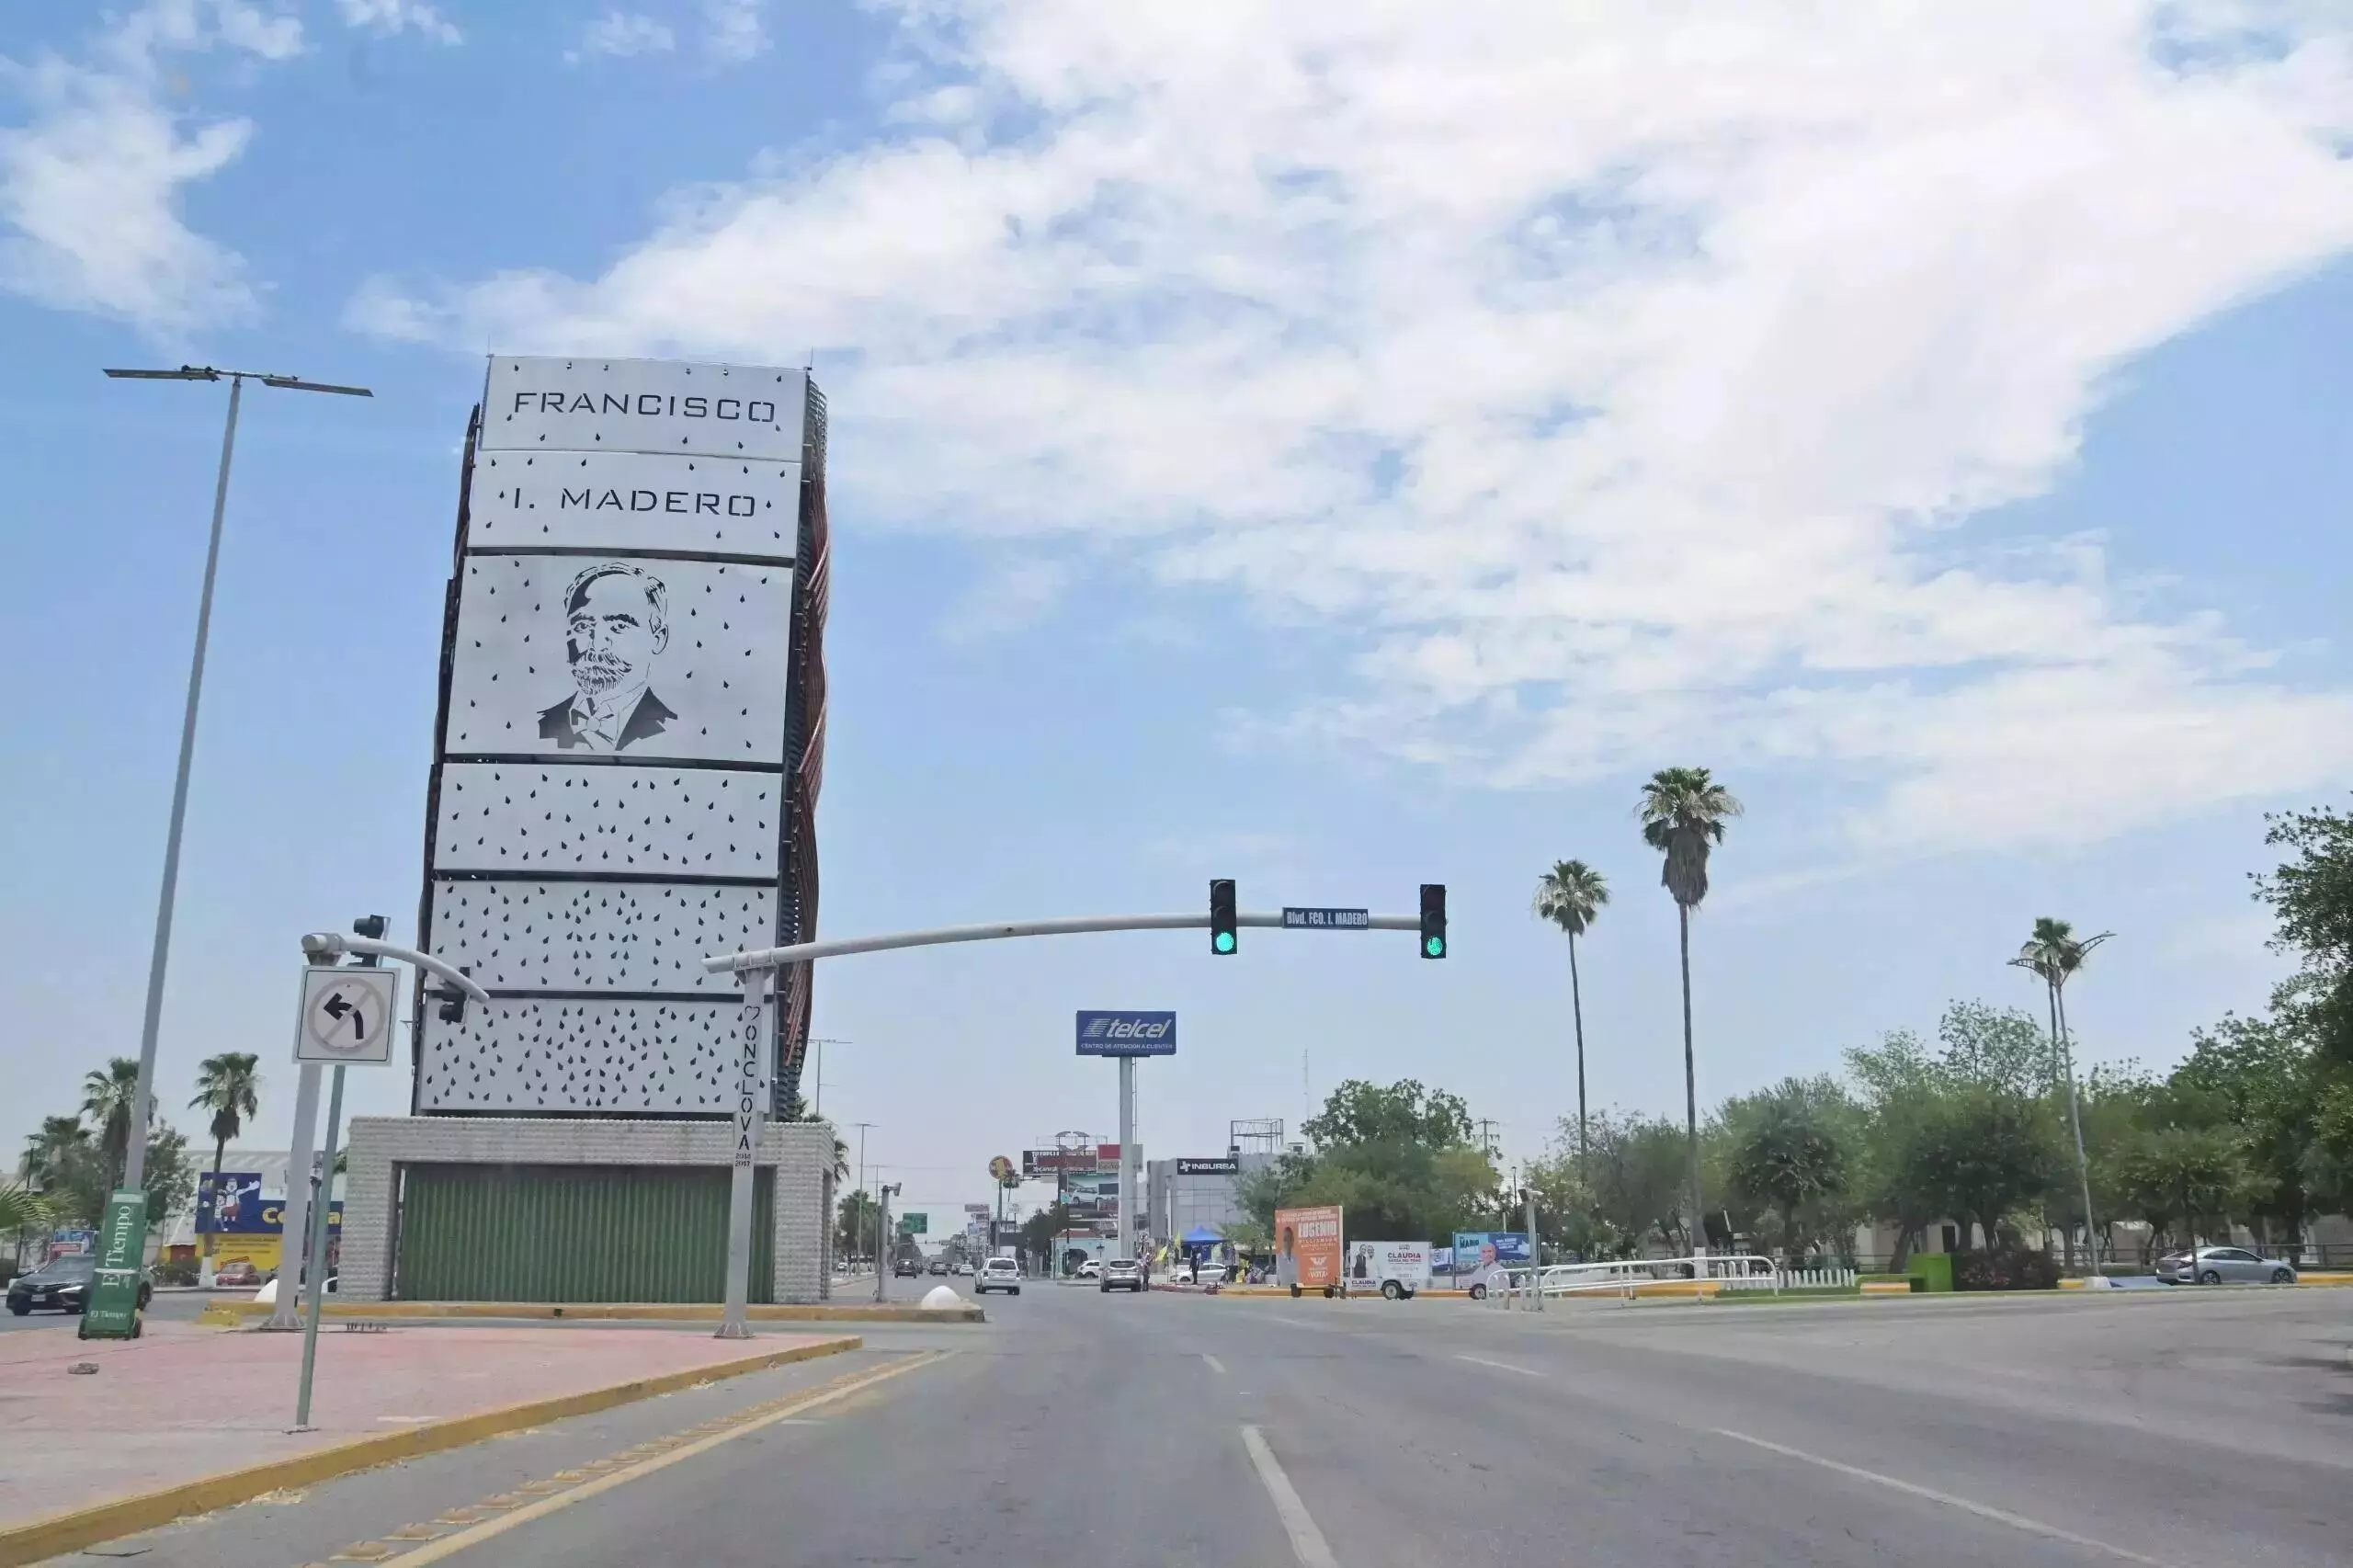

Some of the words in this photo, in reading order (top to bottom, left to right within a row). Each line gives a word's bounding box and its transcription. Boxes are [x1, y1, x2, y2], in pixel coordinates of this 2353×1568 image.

[514, 392, 775, 422] FRANCISCO
[514, 488, 535, 508] I.
[561, 488, 756, 517] MADERO
[1287, 911, 1306, 925] Blvd.
[1309, 912, 1326, 925] FCO.
[1336, 912, 1368, 926] MADERO
[1106, 1018, 1172, 1038] telcel
[105, 1205, 132, 1267] Tiempo
[1299, 1221, 1337, 1238] EUGENIO
